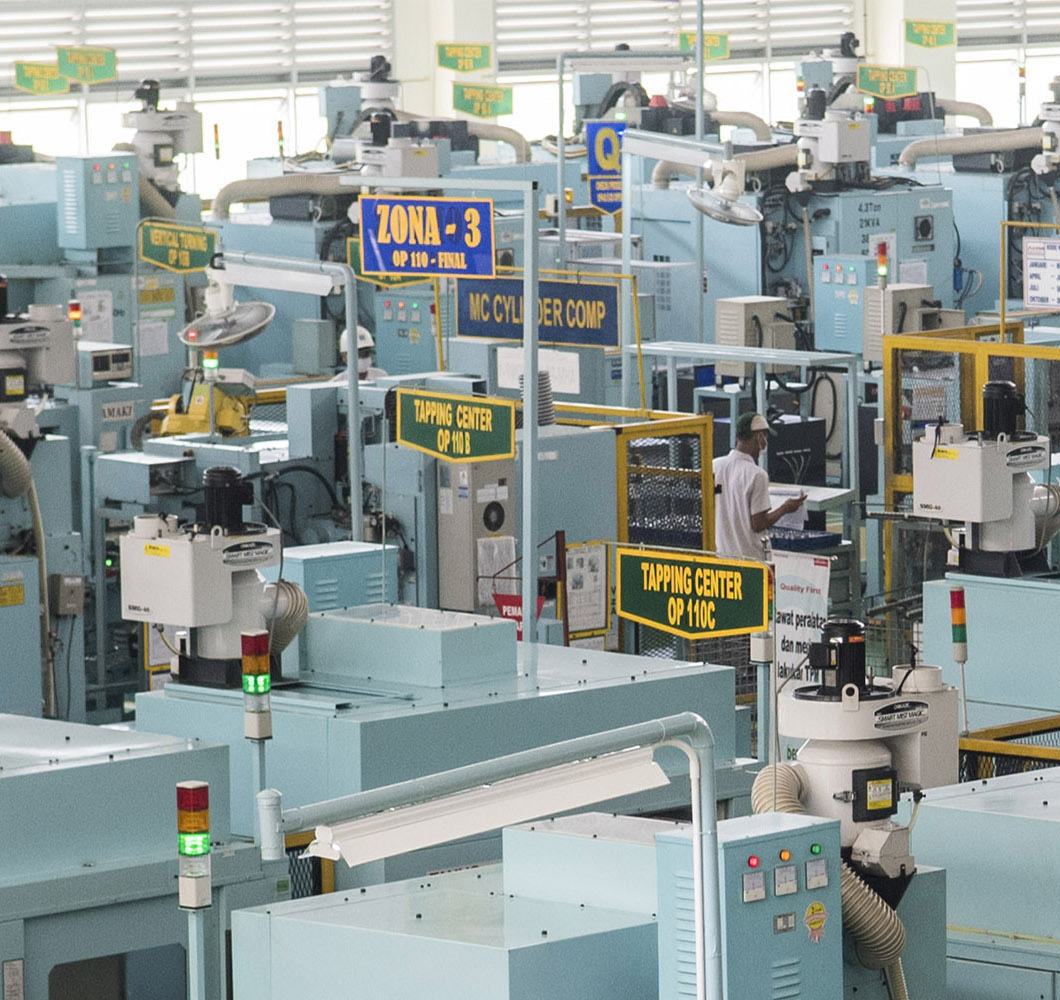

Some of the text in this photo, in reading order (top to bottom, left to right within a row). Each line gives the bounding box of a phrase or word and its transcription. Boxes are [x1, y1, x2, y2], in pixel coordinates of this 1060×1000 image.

[595, 127, 621, 173] Q
[376, 204, 441, 246] ZONA
[464, 208, 481, 248] 3
[392, 250, 409, 268] OP
[411, 251, 428, 268] 110
[438, 251, 467, 270] FINAL
[469, 291, 606, 328] MC CYLIDER COMP
[414, 399, 492, 432] TAPPING CENTER
[437, 429, 471, 455] OP 110 B
[641, 562, 743, 601] TAPPING CENTER
[780, 582, 821, 595] Quality First
[502, 605, 522, 617] PEMA
[668, 597, 716, 630] OP 110C
[776, 609, 794, 625] awat
[781, 634, 810, 655] dan mes
